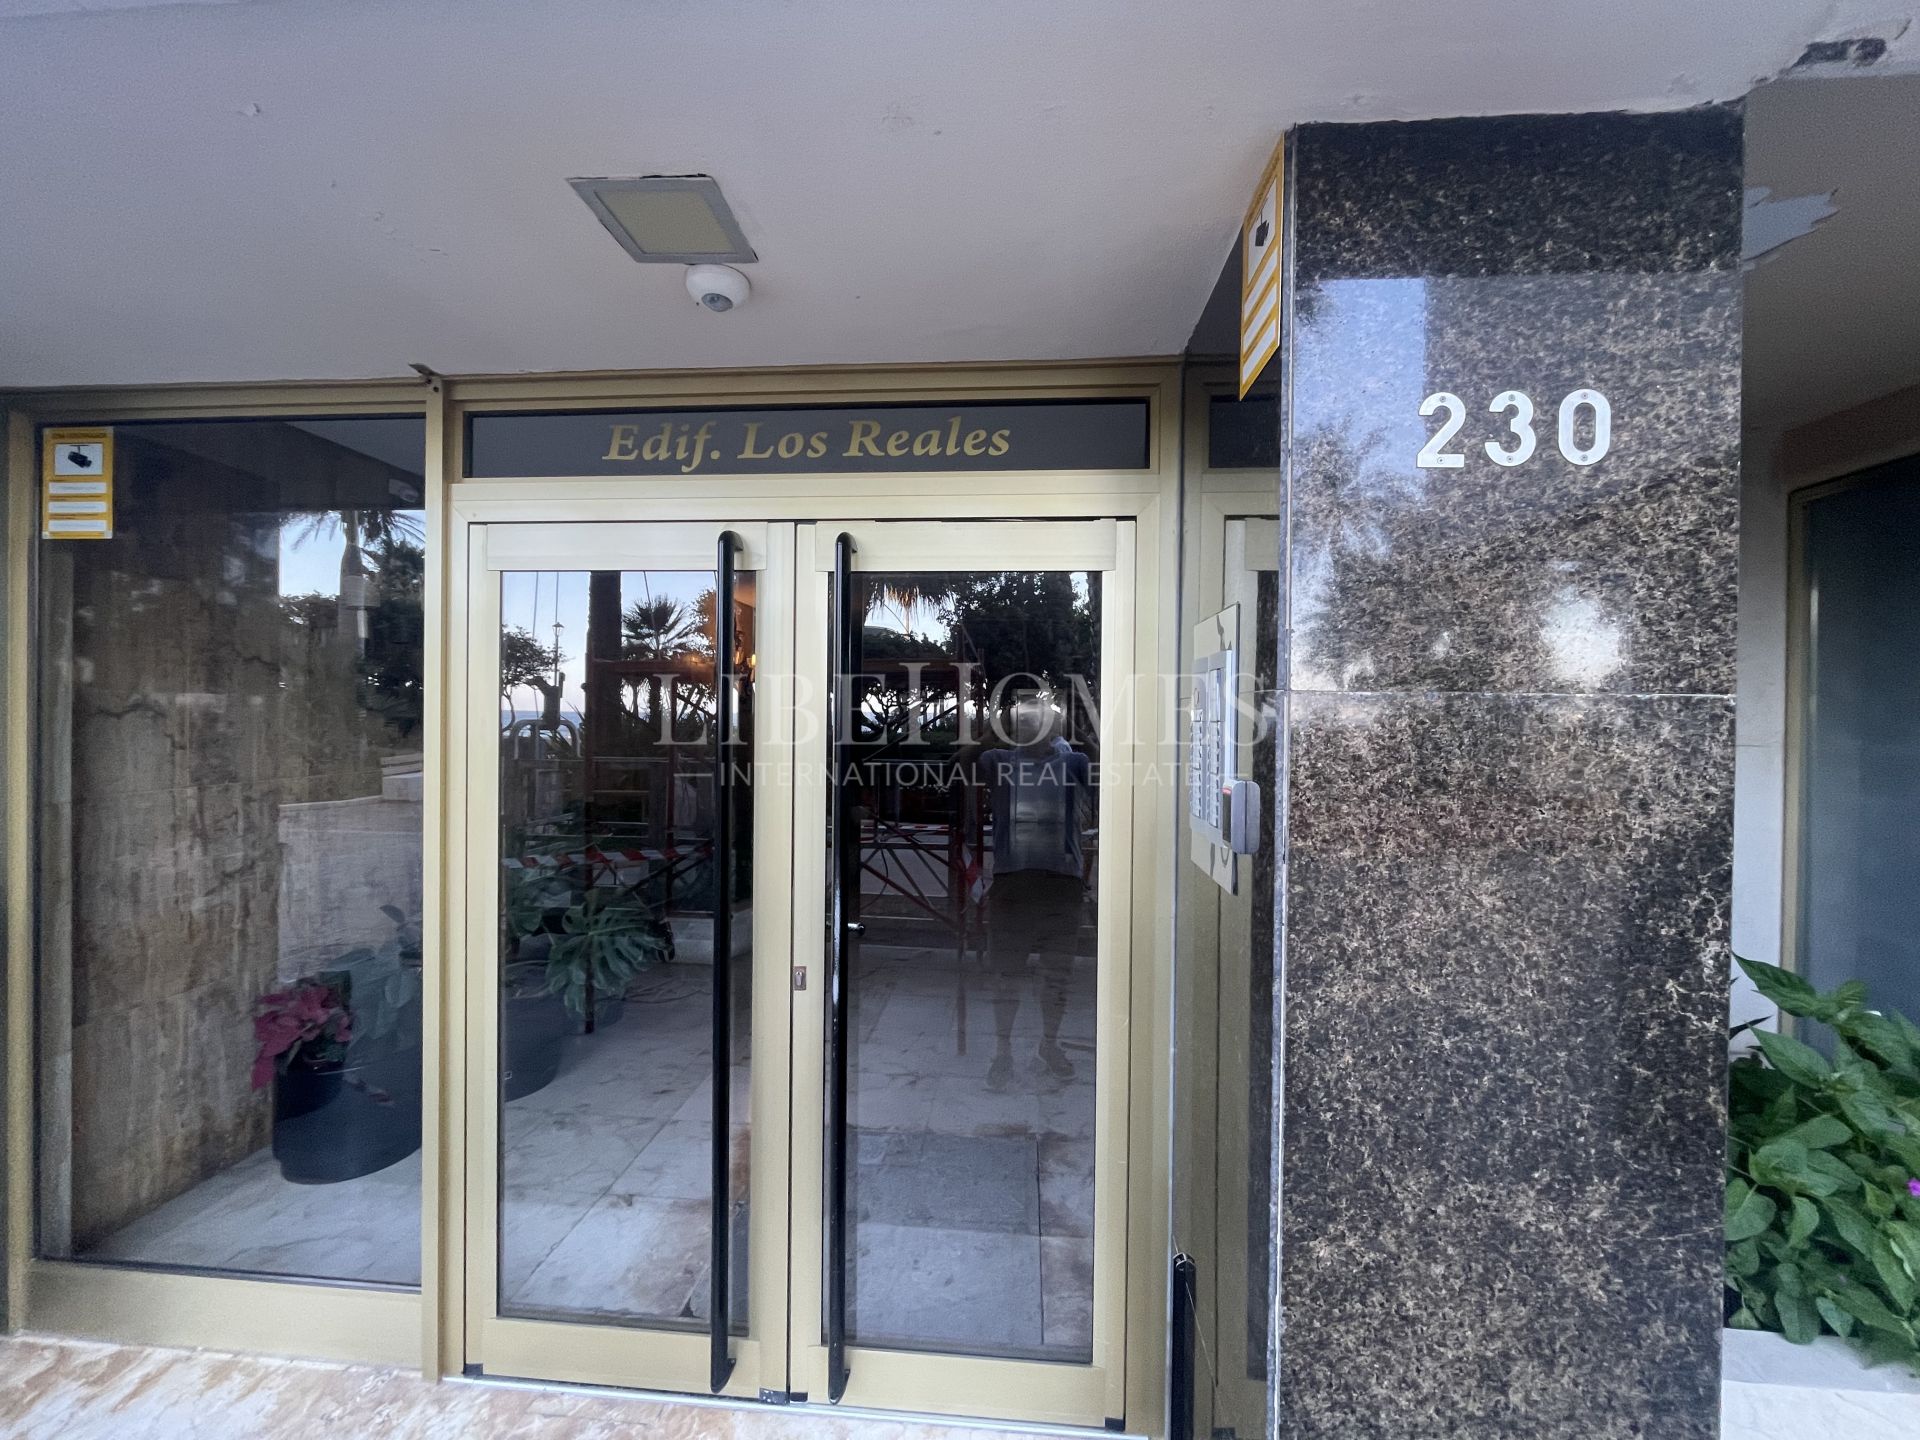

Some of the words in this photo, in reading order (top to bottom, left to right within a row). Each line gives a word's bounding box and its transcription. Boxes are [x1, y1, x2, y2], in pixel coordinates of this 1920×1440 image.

[602, 422, 721, 473] Edif.
[736, 421, 829, 459] Los
[842, 415, 1012, 457] Reales
[1416, 388, 1612, 468] 230
